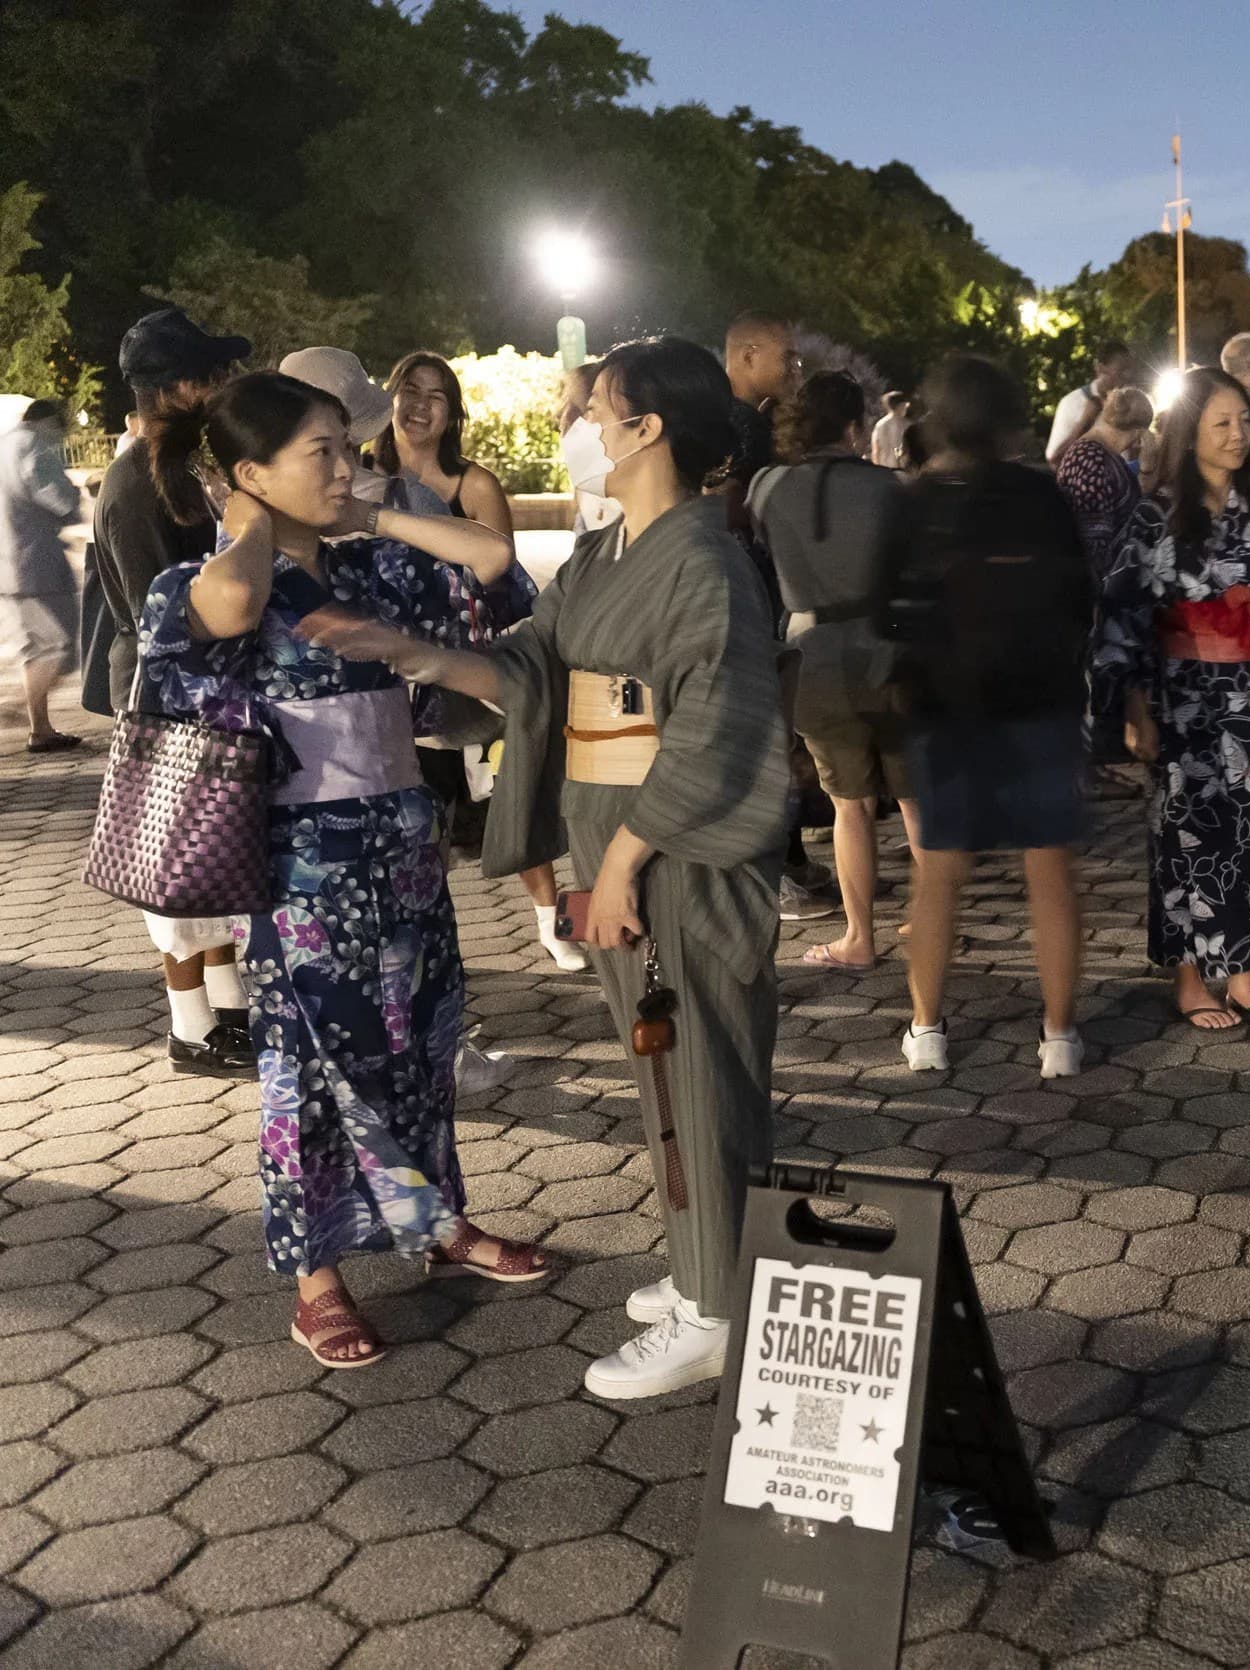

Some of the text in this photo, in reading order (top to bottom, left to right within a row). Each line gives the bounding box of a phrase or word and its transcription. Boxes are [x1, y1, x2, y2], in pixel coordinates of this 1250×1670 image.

[767, 1276, 906, 1331] FREE
[760, 1318, 903, 1380] STARGAZING
[758, 1367, 895, 1401] COURTESY OF
[746, 1446, 885, 1478] AMATEUR ASTRONOMERS
[776, 1465, 849, 1486] ASSOCIATION
[765, 1479, 854, 1511] aaa.org
